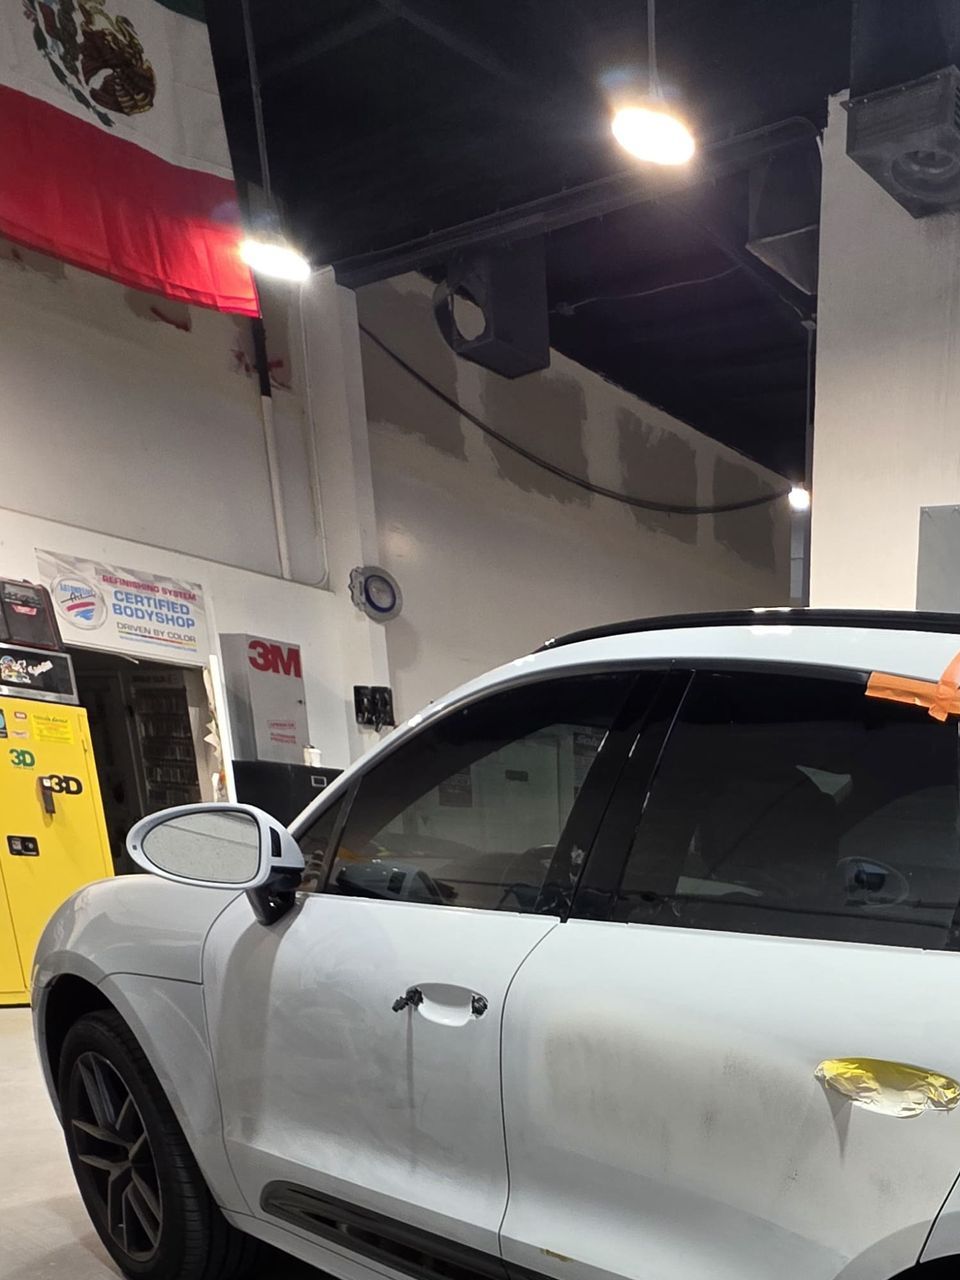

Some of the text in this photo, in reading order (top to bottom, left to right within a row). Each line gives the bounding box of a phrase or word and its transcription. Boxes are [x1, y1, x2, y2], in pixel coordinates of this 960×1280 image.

[102, 574, 160, 593] REFINISHING
[161, 587, 197, 602] SYSTEM
[112, 603, 195, 629] BODYSHOP
[113, 590, 190, 616] CERTIFIED
[116, 621, 197, 643] DRIVEN BY COLOR
[248, 639, 302, 679] 3M
[9, 748, 36, 767] 3D
[49, 774, 83, 795] 3D
